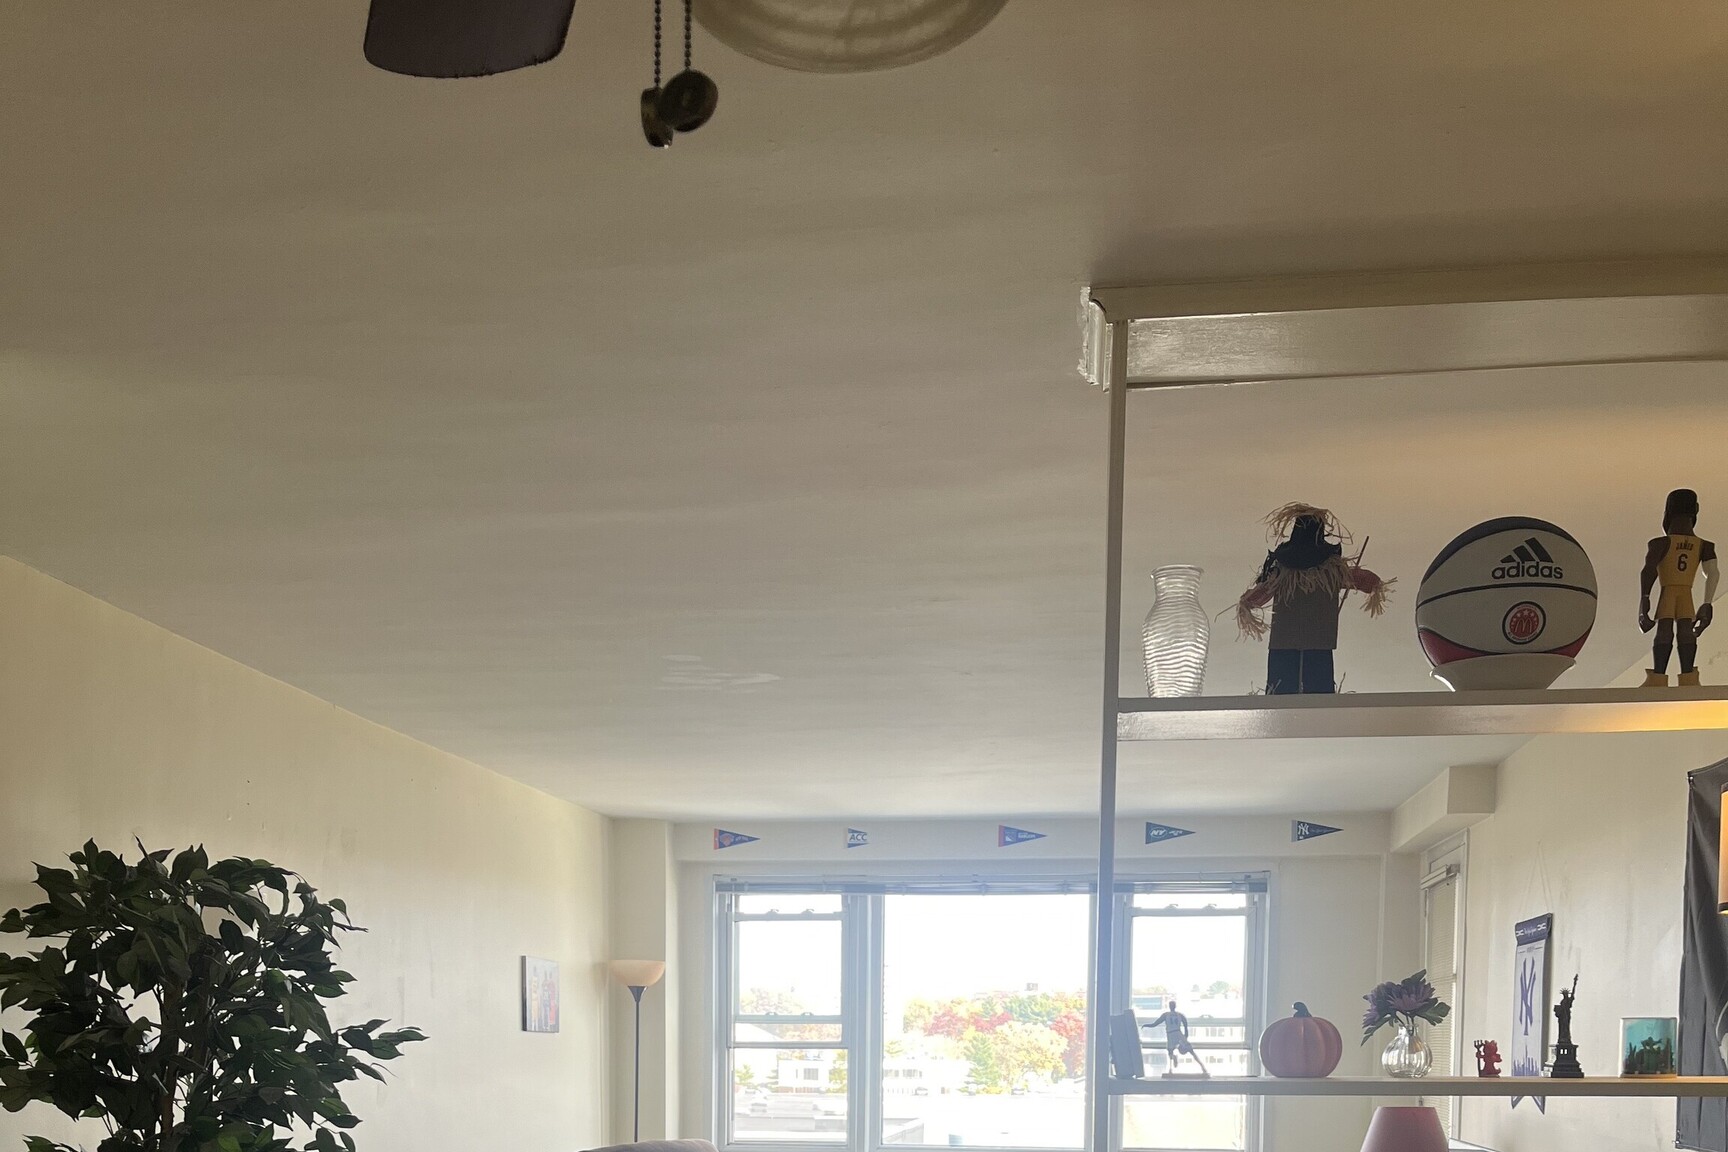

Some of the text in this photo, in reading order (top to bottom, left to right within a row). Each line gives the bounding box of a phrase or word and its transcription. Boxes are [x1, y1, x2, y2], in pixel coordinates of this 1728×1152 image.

[1491, 560, 1564, 580] adidas
[1677, 553, 1688, 572] 6
[849, 833, 868, 842] ACC
